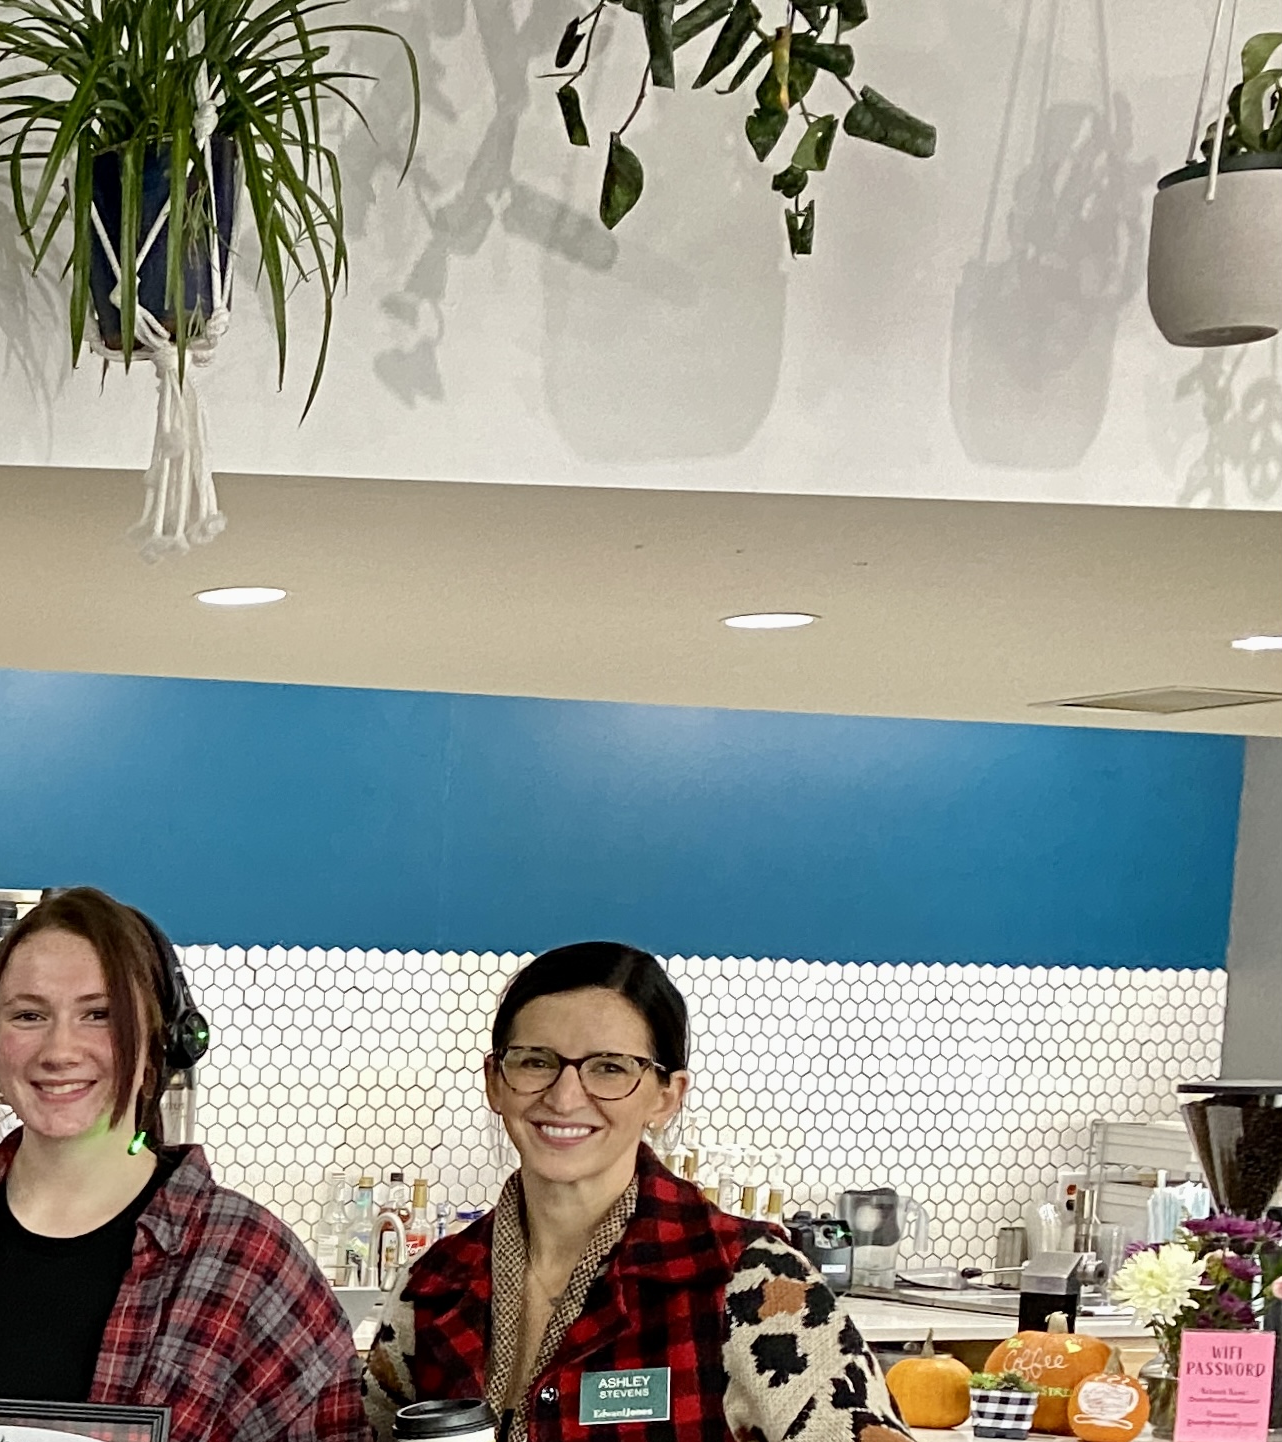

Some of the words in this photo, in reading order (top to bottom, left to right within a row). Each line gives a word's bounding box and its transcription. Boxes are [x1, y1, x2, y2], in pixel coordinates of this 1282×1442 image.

[1212, 1346, 1243, 1359] WIFI
[1004, 1348, 1069, 1381] Coffee
[1187, 1362, 1265, 1377] PASSWORD
[598, 1376, 650, 1388] ASHLEY
[599, 1388, 649, 1399] STEVENS
